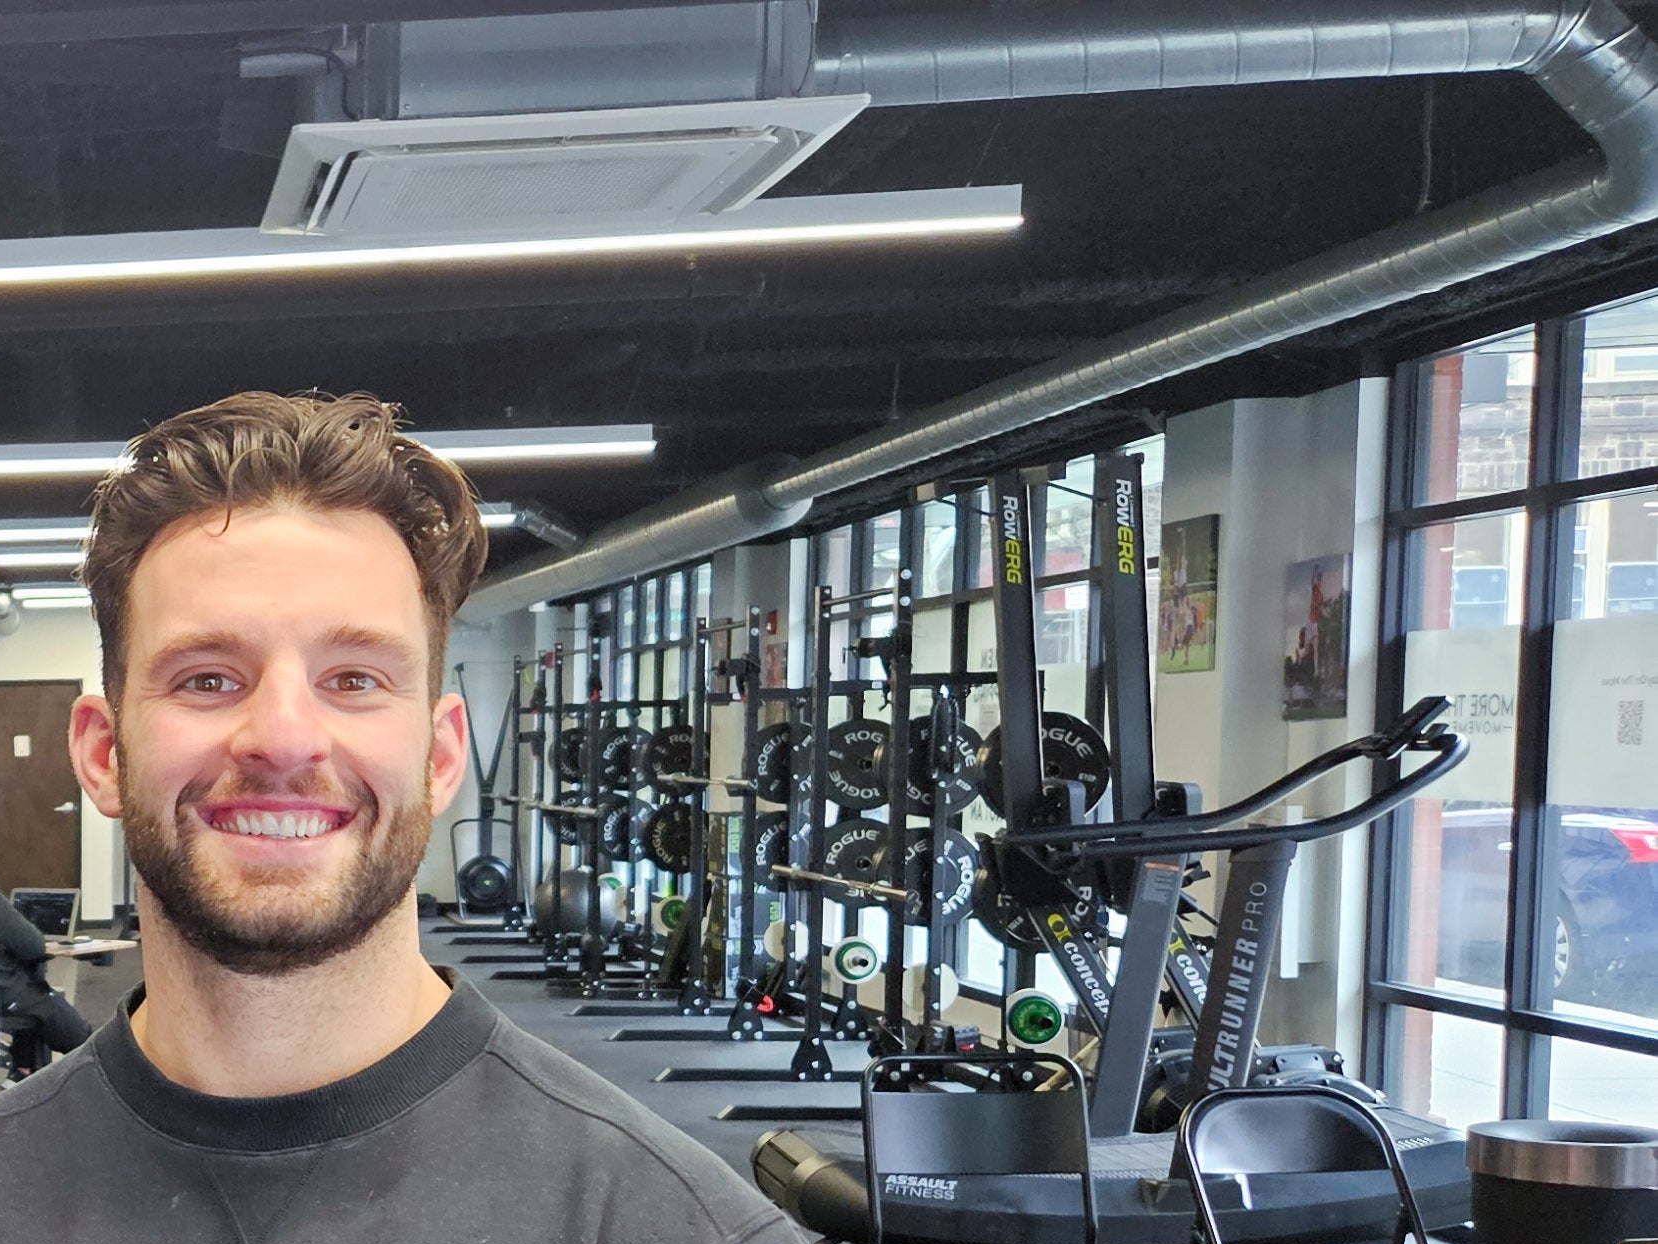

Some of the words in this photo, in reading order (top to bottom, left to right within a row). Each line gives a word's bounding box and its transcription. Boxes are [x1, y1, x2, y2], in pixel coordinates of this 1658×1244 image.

[844, 730, 885, 745] ROG
[651, 819, 676, 864] ROGUE
[825, 829, 880, 866] ROGUE
[1241, 881, 1268, 933] PRO
[885, 1174, 959, 1191] ASSAULT
[885, 1183, 956, 1201] FITNESS
